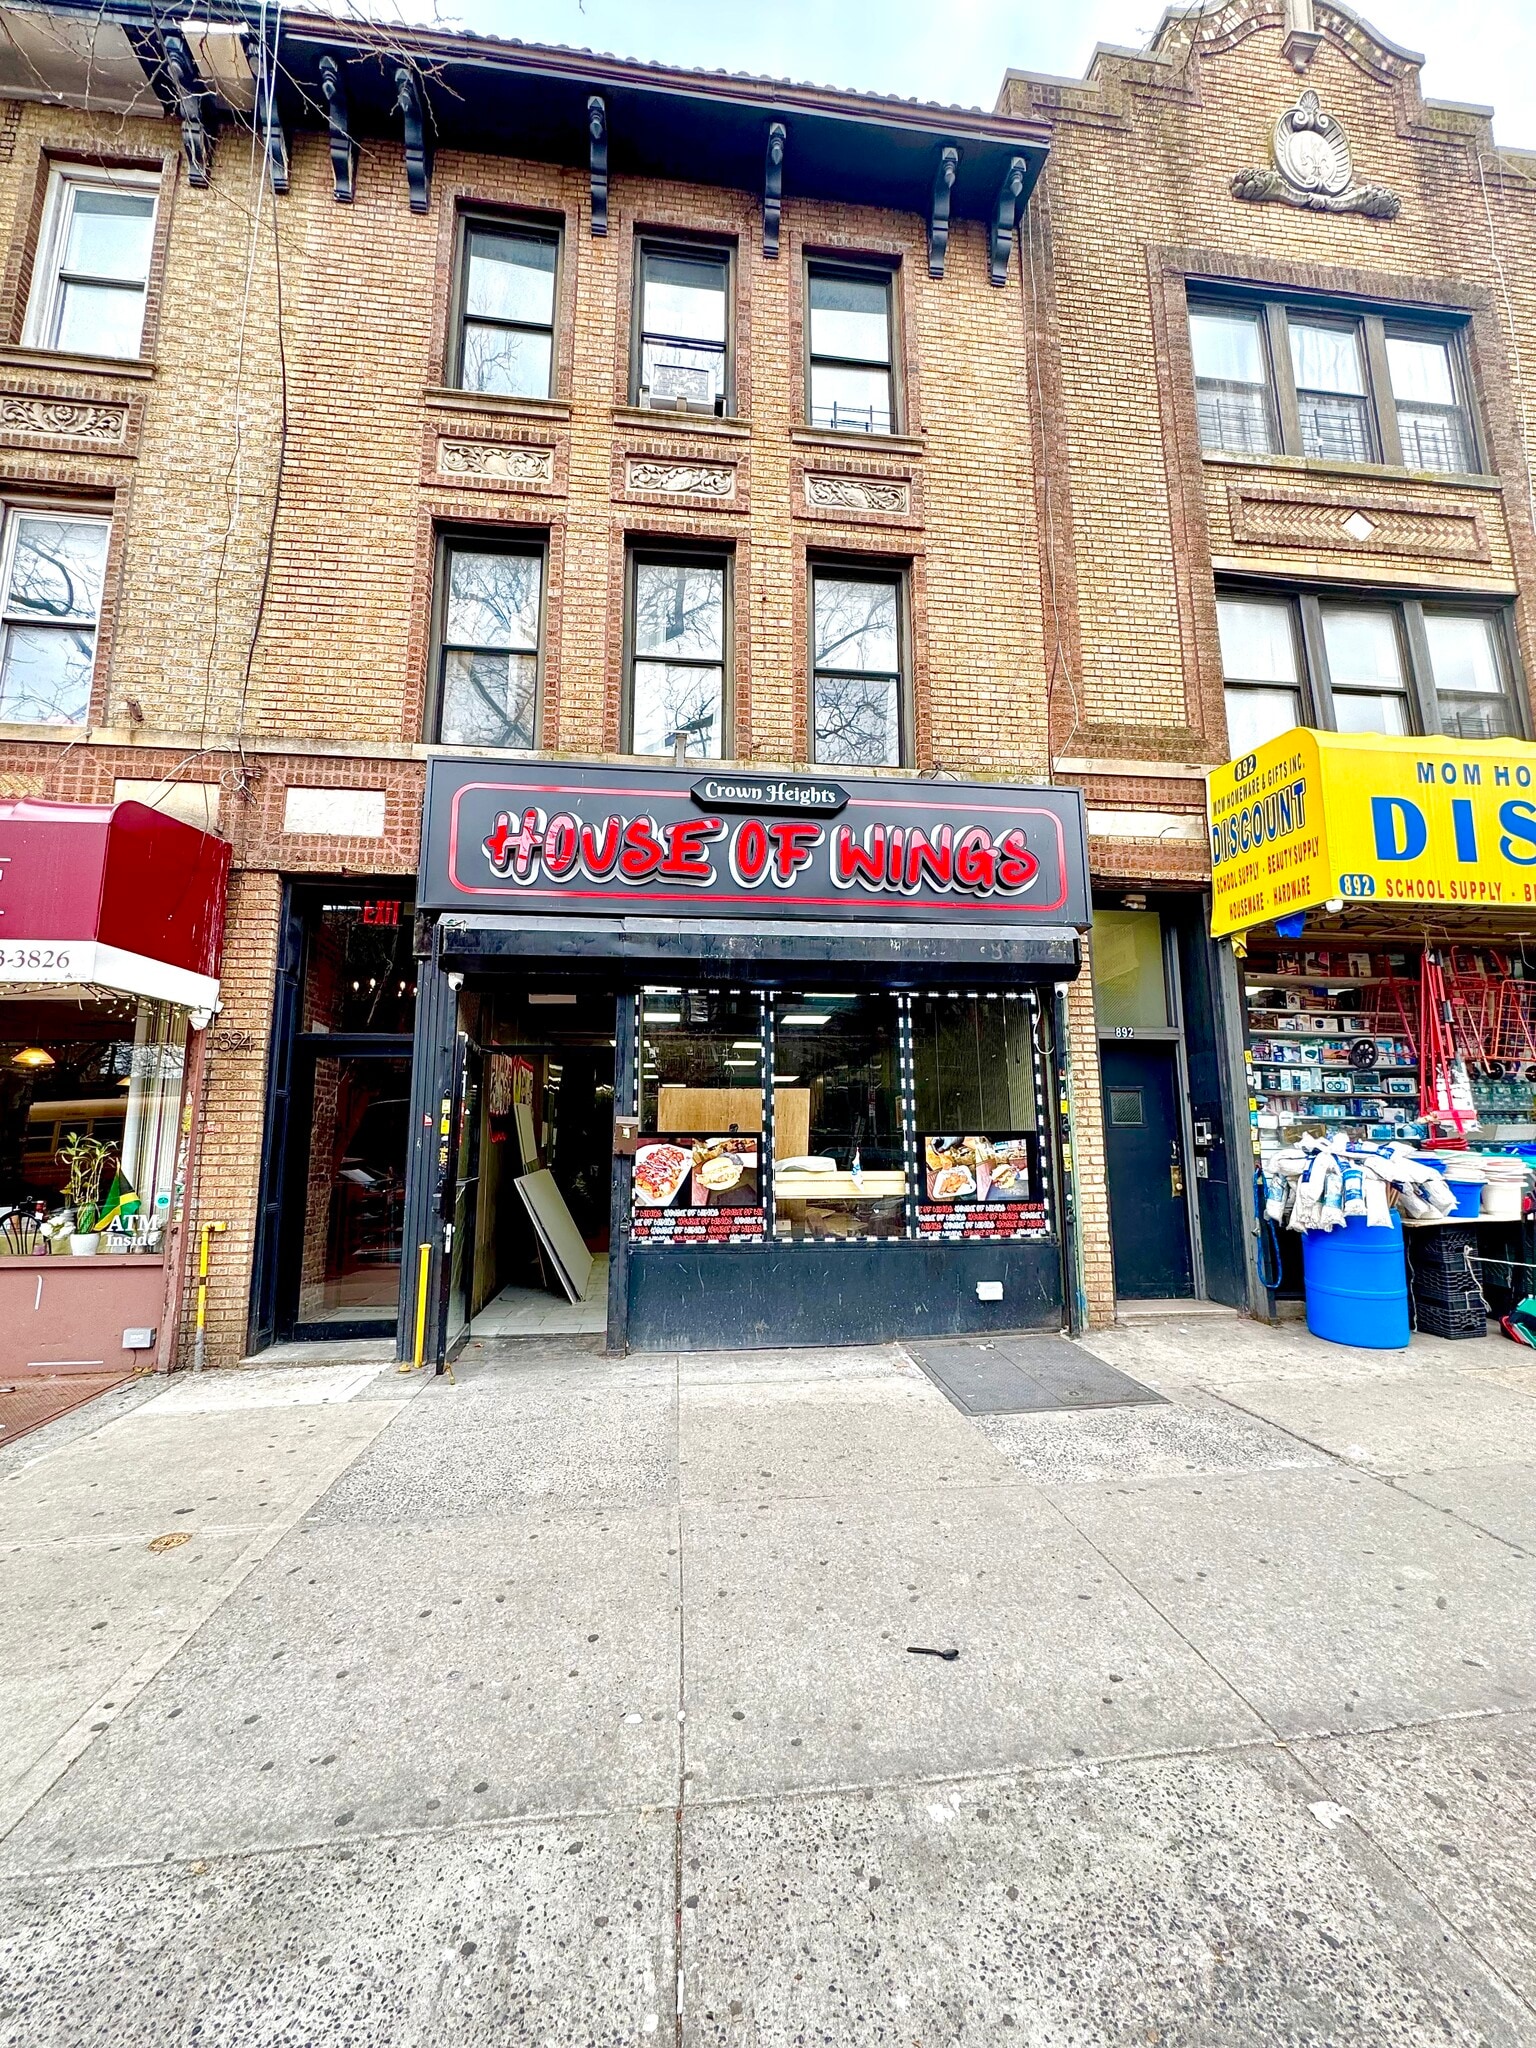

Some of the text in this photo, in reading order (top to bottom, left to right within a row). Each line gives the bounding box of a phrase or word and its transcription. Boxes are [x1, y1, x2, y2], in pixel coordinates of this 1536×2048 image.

[1236, 757, 1254, 781] 892
[1416, 762, 1531, 787] MOM HO
[705, 781, 836, 804] Crown Heights
[1227, 776, 1260, 809] HOMEWARE
[1261, 773, 1266, 790] &
[1267, 761, 1288, 785] GIFTS
[1212, 778, 1306, 867] DISCOUNT
[1371, 796, 1536, 866] DIS
[482, 807, 1040, 897] HOUSE OF WINGS
[1217, 836, 1319, 895] SCHOOL SUPPLY BEAUTY SUPPLY
[1344, 876, 1371, 895] 892
[1386, 878, 1445, 899] SCHOOL
[1450, 880, 1501, 901] SUPPLY
[1229, 876, 1311, 921] HOUSEWARE HARDWARE
[363, 901, 402, 925] EXIT
[219, 1031, 254, 1052] 894
[1115, 1027, 1134, 1038] 892
[106, 1214, 159, 1232] ATM
[106, 1234, 158, 1246] Inside
